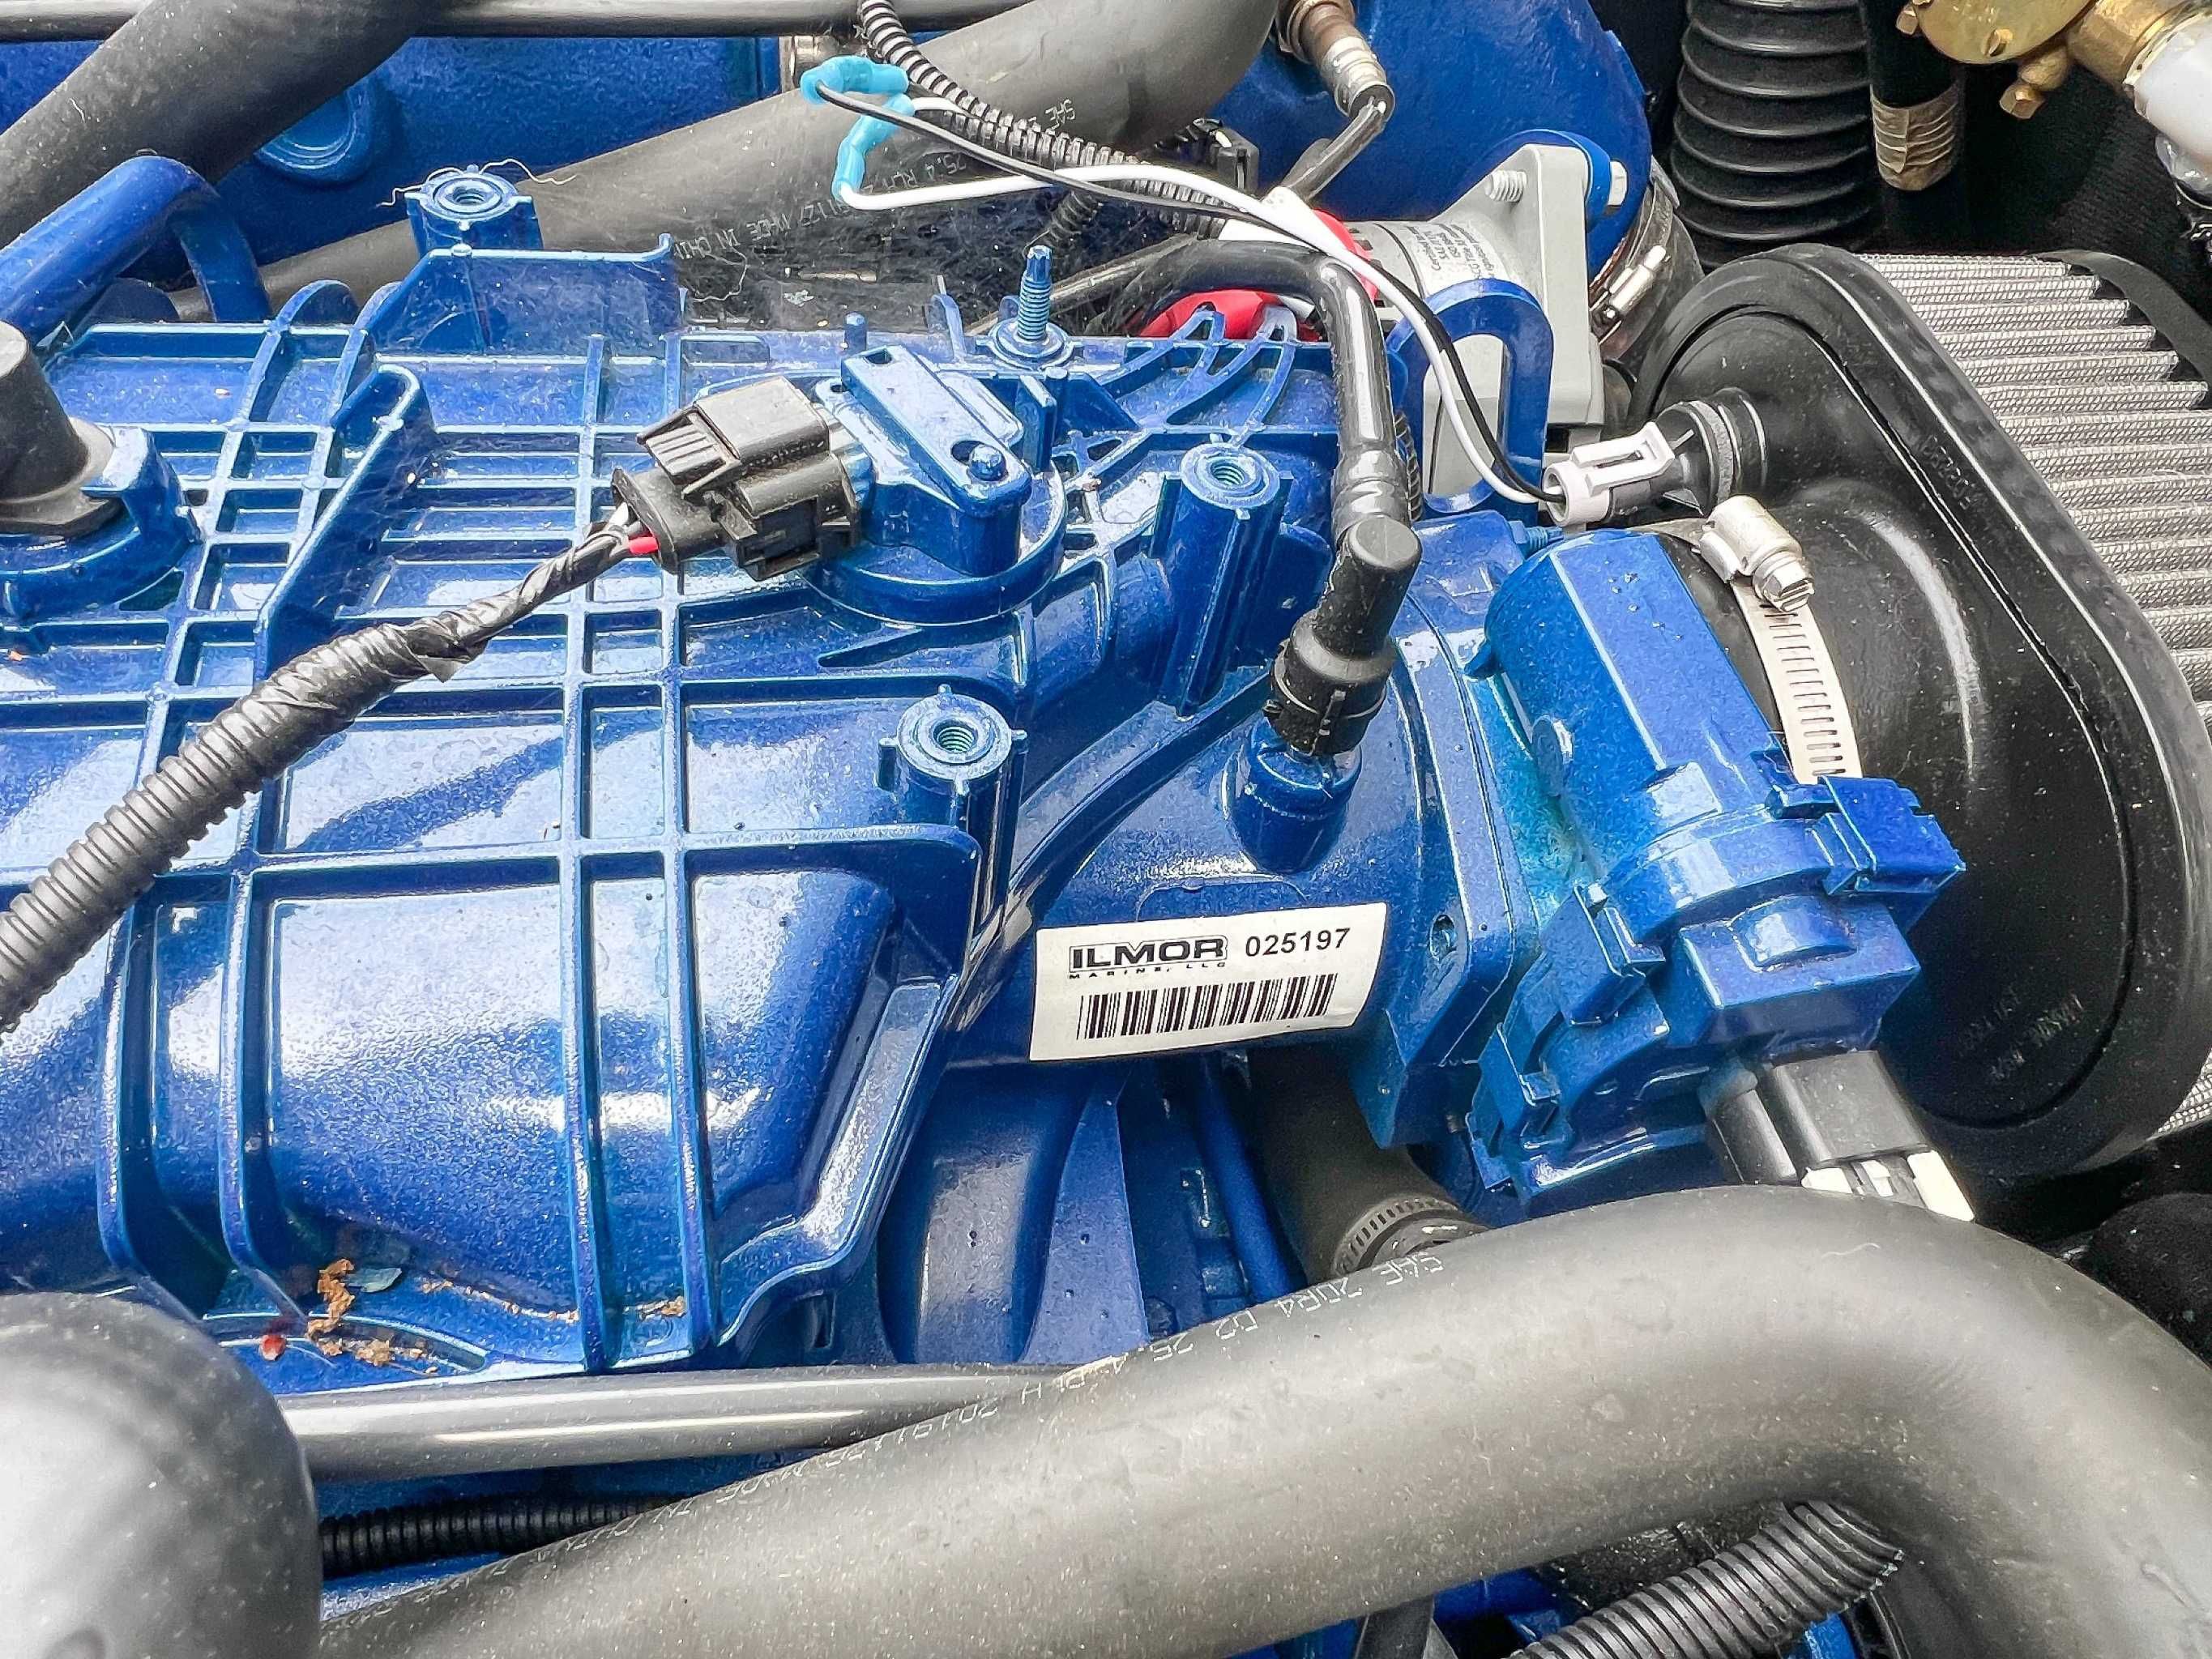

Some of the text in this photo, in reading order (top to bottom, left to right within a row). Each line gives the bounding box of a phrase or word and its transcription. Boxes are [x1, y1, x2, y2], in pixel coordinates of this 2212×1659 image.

[715, 228, 741, 249] IN
[1072, 927, 1351, 970] ILMOR 025197
[1372, 1251, 1445, 1286] SAE
